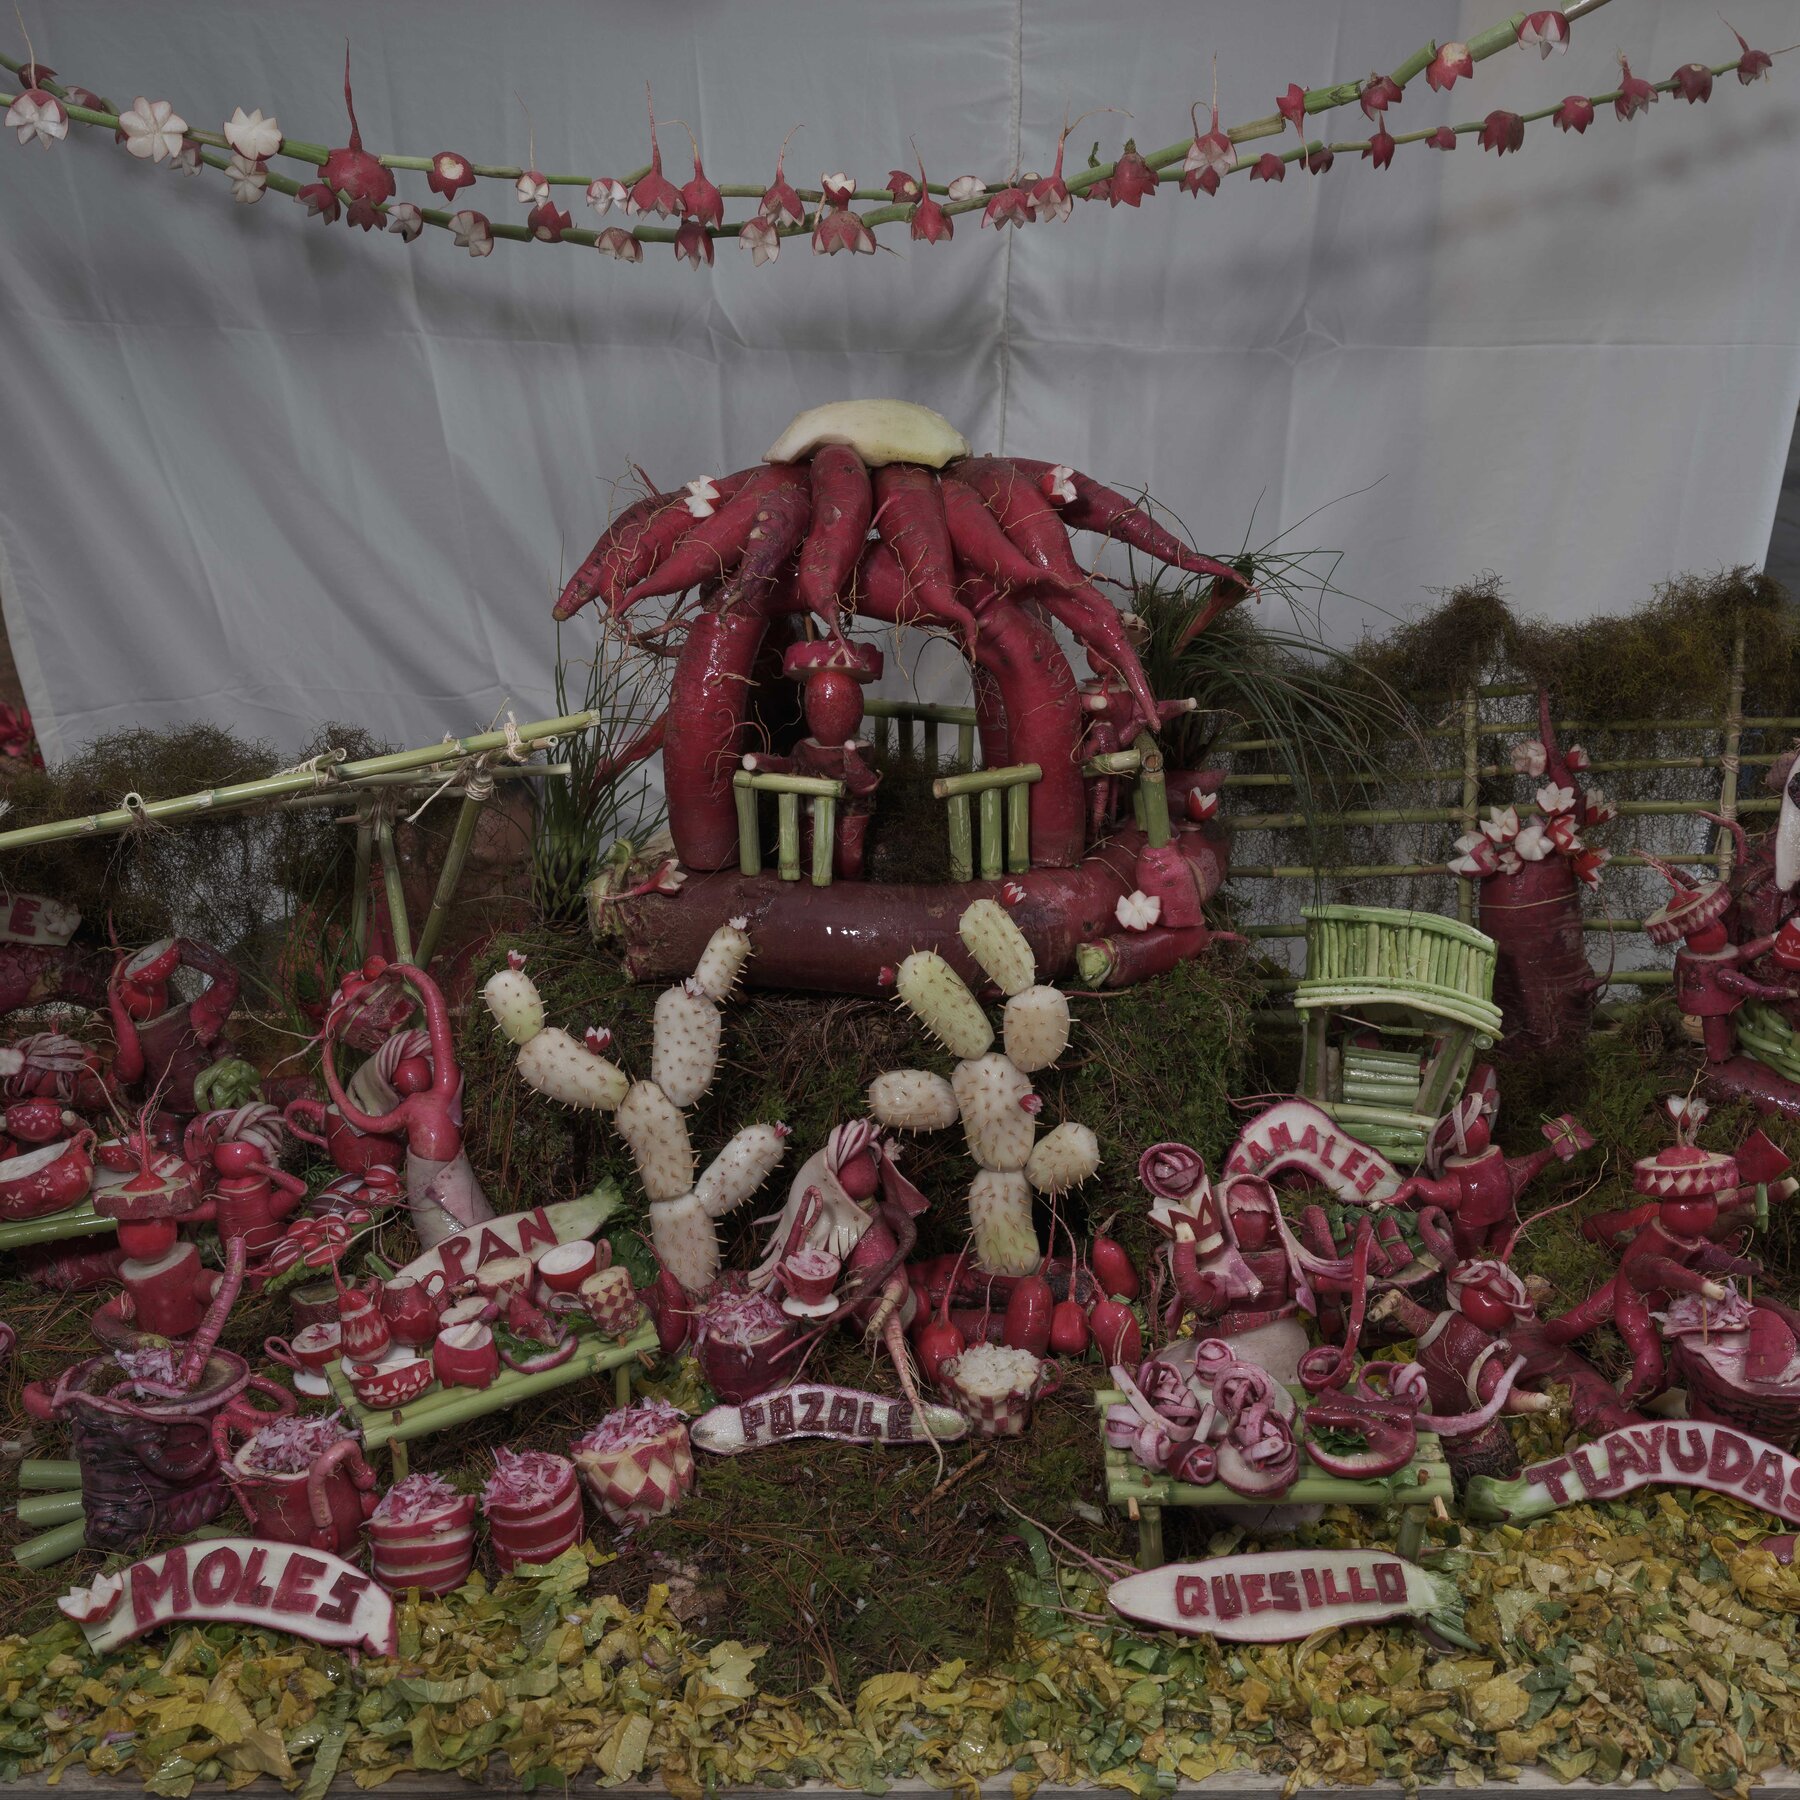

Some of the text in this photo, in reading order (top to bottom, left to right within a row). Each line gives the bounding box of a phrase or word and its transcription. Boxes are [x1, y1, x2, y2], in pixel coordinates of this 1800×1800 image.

[0, 895, 41, 937] E
[1229, 1121, 1386, 1195] TAMALES
[438, 1206, 559, 1283] PAN
[740, 1391, 914, 1442] POZOLE
[130, 1546, 371, 1628] MOLES
[1174, 1562, 1408, 1620] QUESILLO
